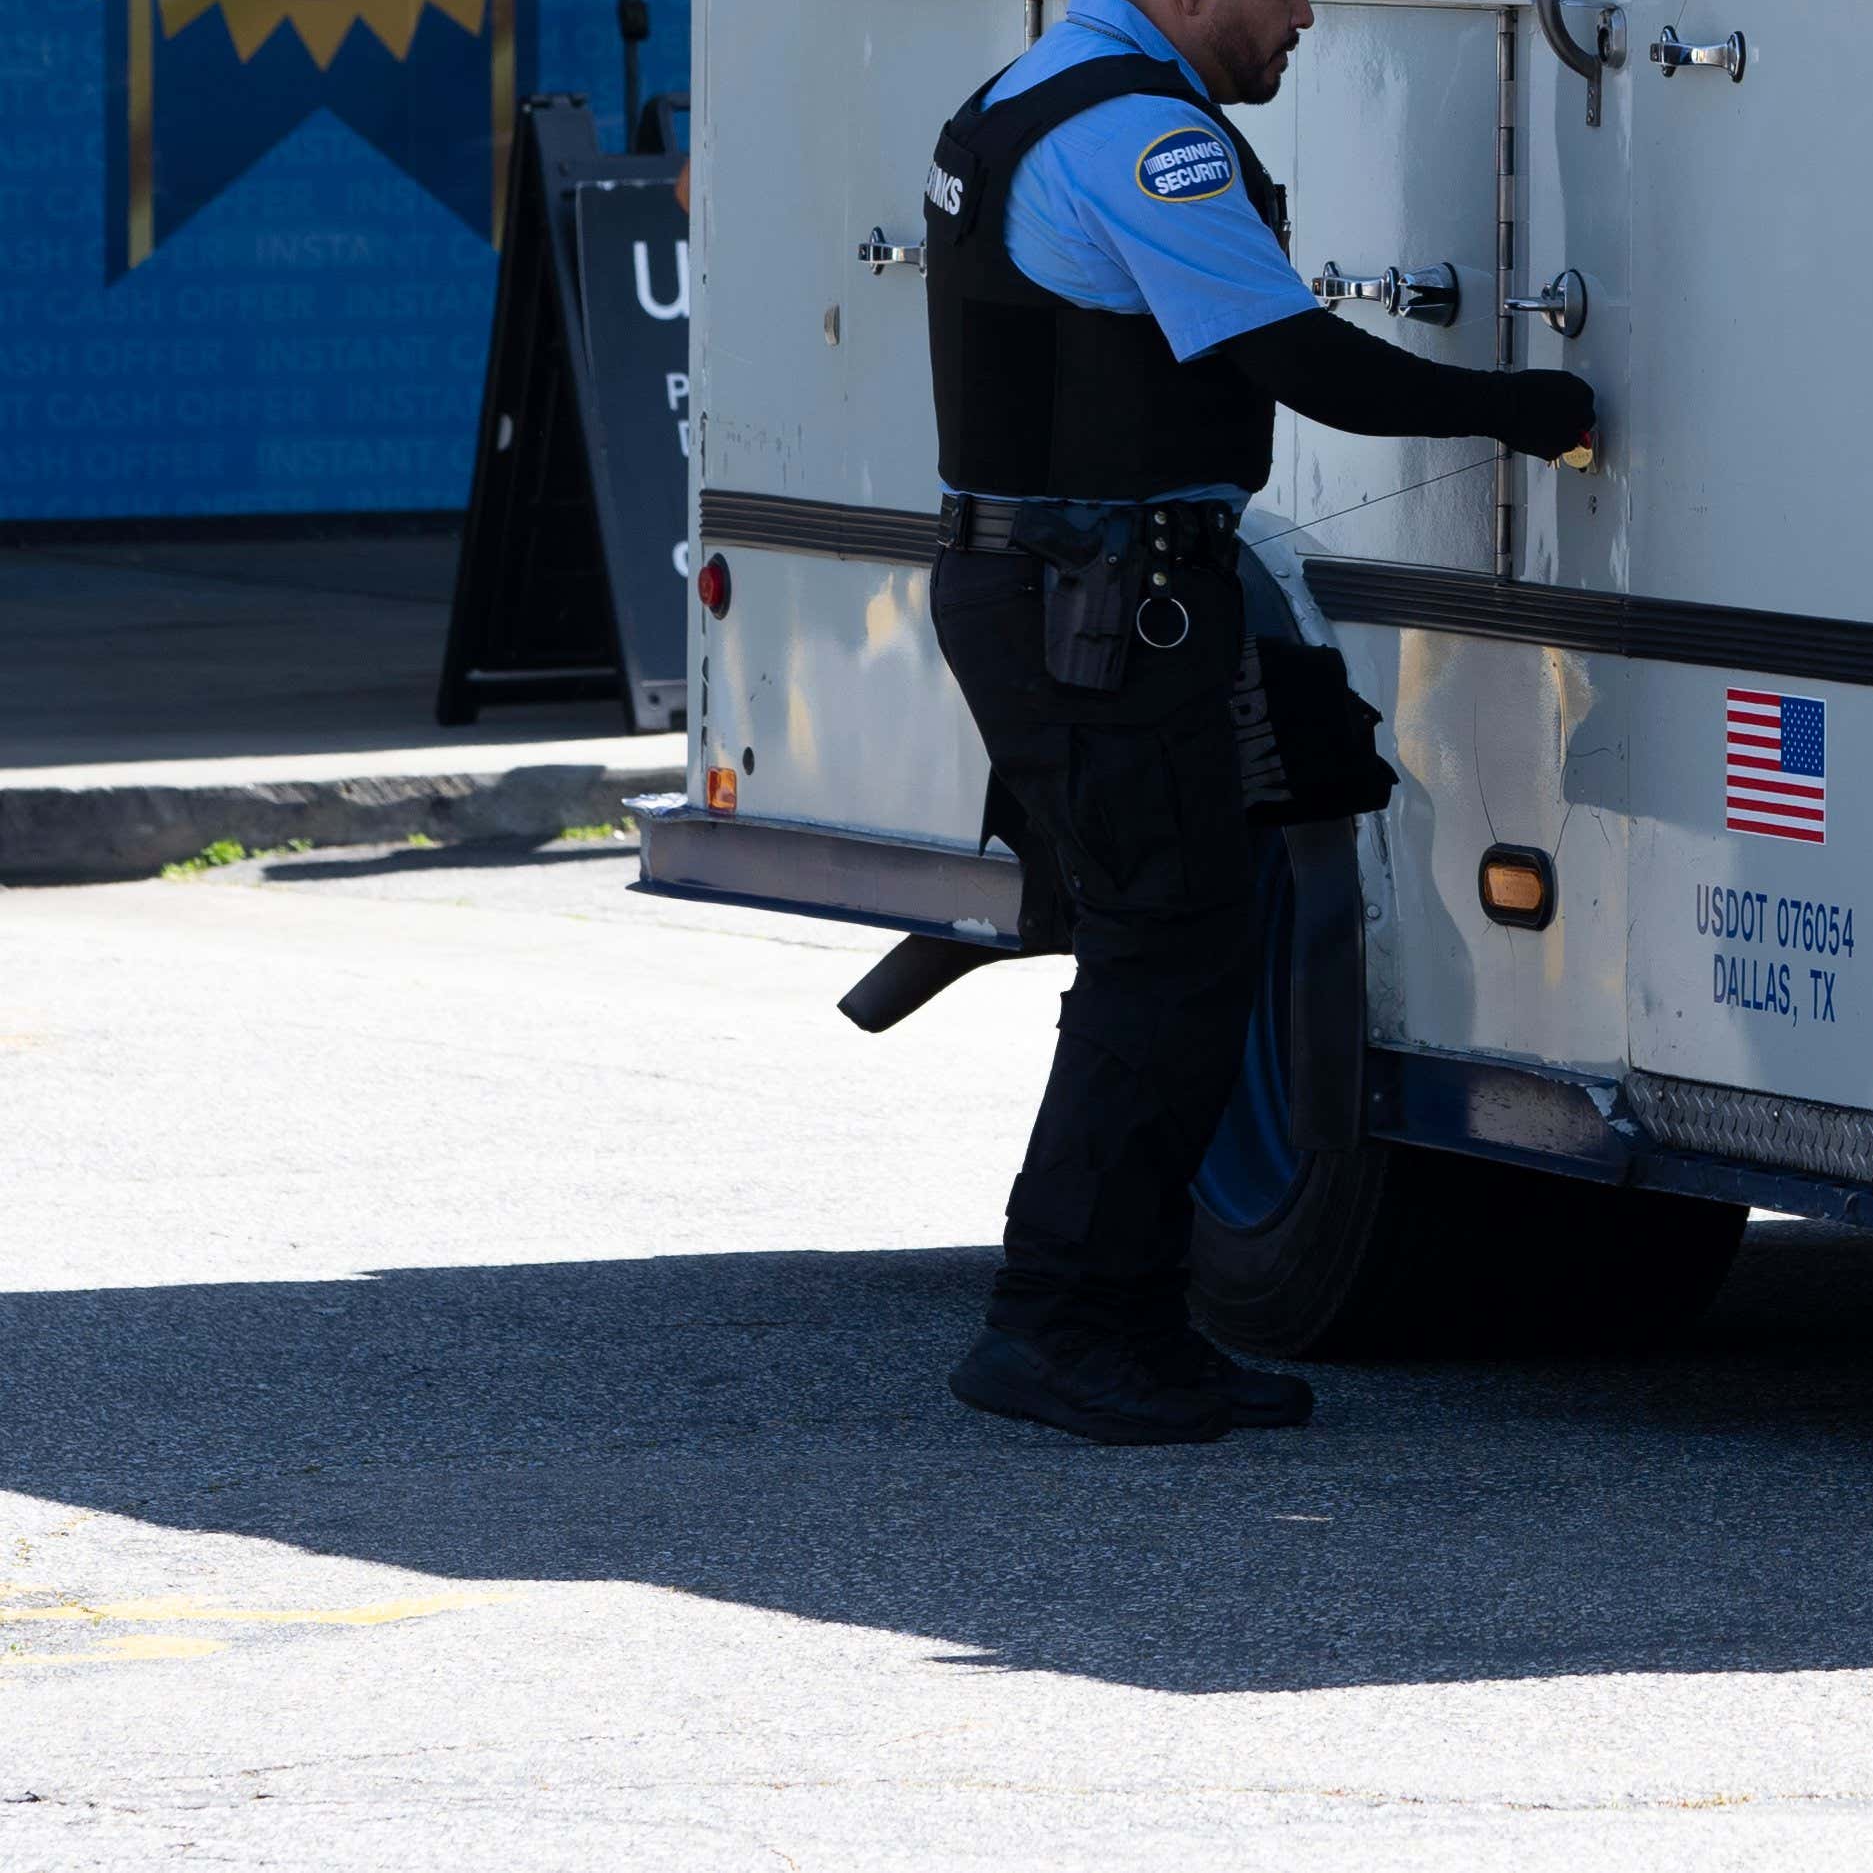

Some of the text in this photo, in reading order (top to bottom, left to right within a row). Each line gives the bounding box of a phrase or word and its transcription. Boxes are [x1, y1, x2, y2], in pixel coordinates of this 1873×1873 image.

[1154, 160, 1230, 195] SECURITY
[1159, 140, 1224, 169] BRINKS
[1696, 883, 1855, 958] USDOT 076054
[1713, 954, 1837, 1028] DALLAS, TX
